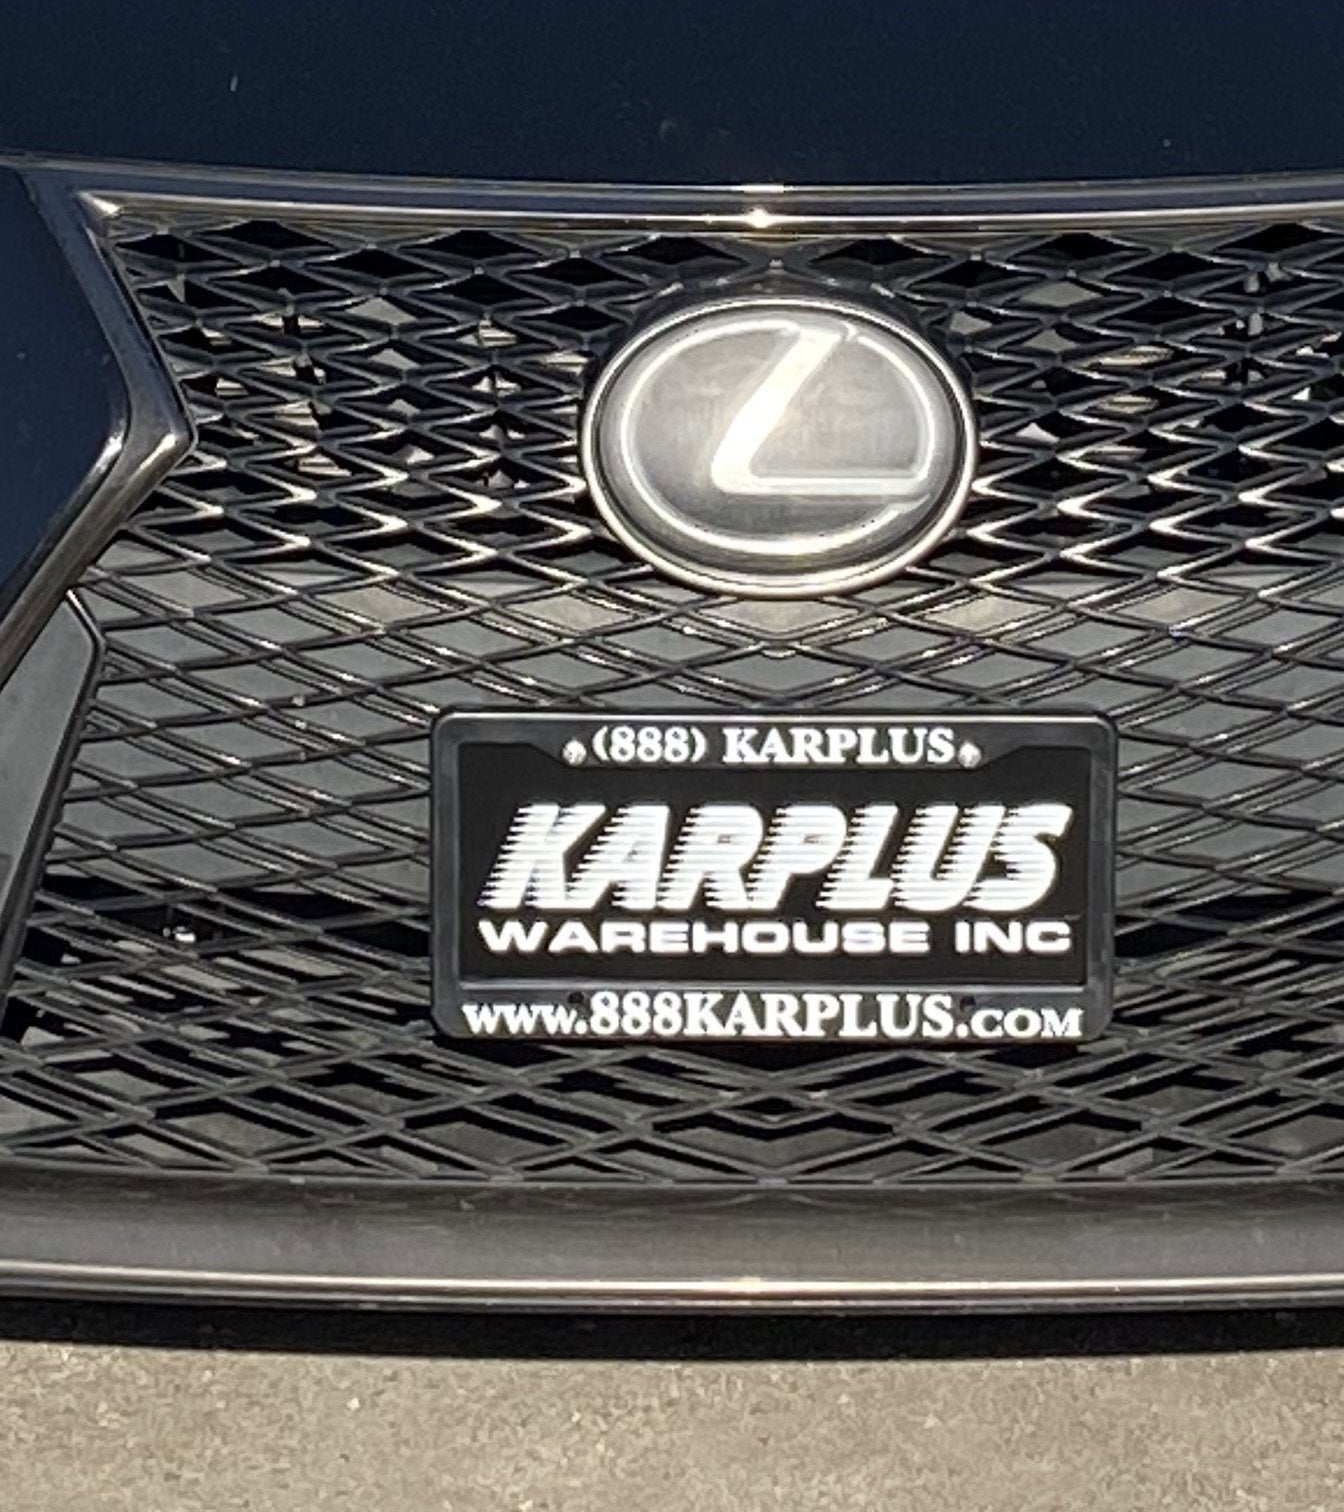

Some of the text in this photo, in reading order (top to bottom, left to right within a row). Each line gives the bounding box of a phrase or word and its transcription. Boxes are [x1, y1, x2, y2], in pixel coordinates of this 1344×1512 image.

[593, 726, 956, 765] (888) KARPLUS
[477, 802, 1074, 913] KARPLUS
[477, 919, 1072, 954] WAREHOUSE INC
